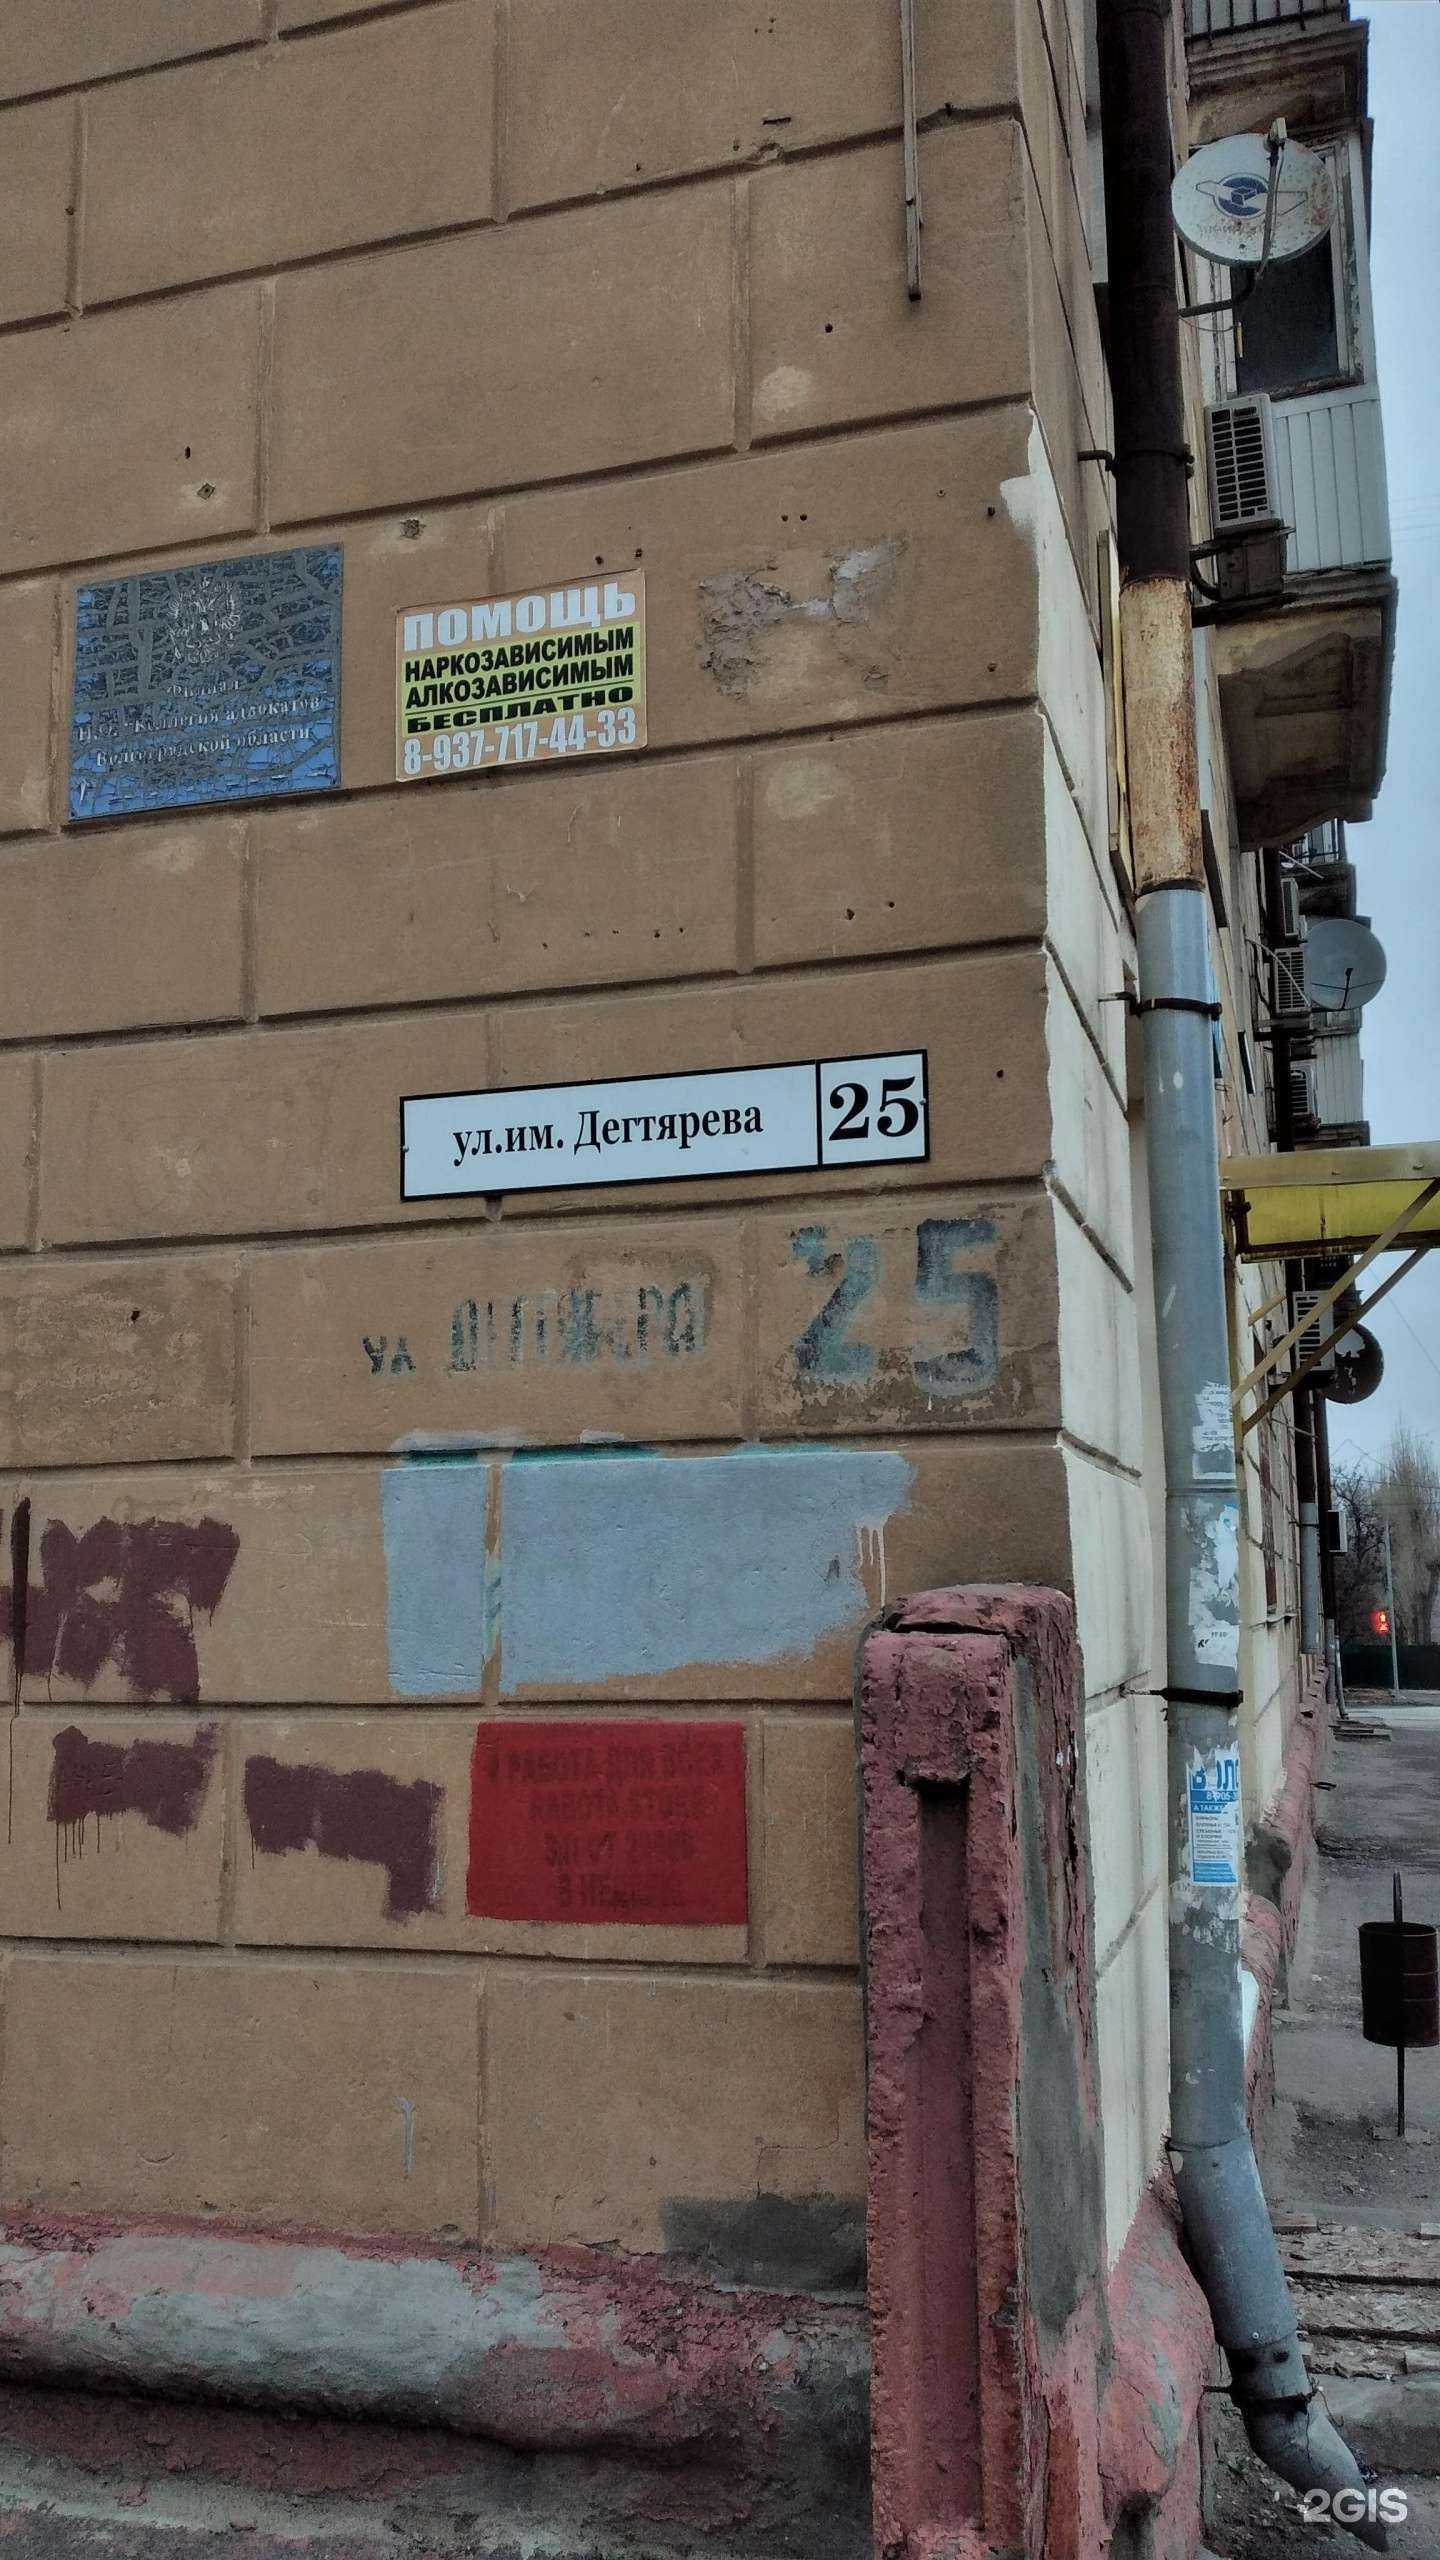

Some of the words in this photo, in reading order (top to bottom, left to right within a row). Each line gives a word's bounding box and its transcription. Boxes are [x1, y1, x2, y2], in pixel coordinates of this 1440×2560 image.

[404, 583, 636, 651] ПОМОЩЬ
[405, 626, 634, 683] НАРКОЗАВИСИМЫМ
[405, 654, 634, 709] АЛКОЗАВИСИМЫМ
[407, 686, 634, 734] БЕСПЛАТНО
[404, 707, 636, 775] 8-937-717-44-33
[574, 1105, 764, 1156] Дегтярева
[829, 1076, 919, 1141] 25
[792, 1218, 1000, 1396] 25
